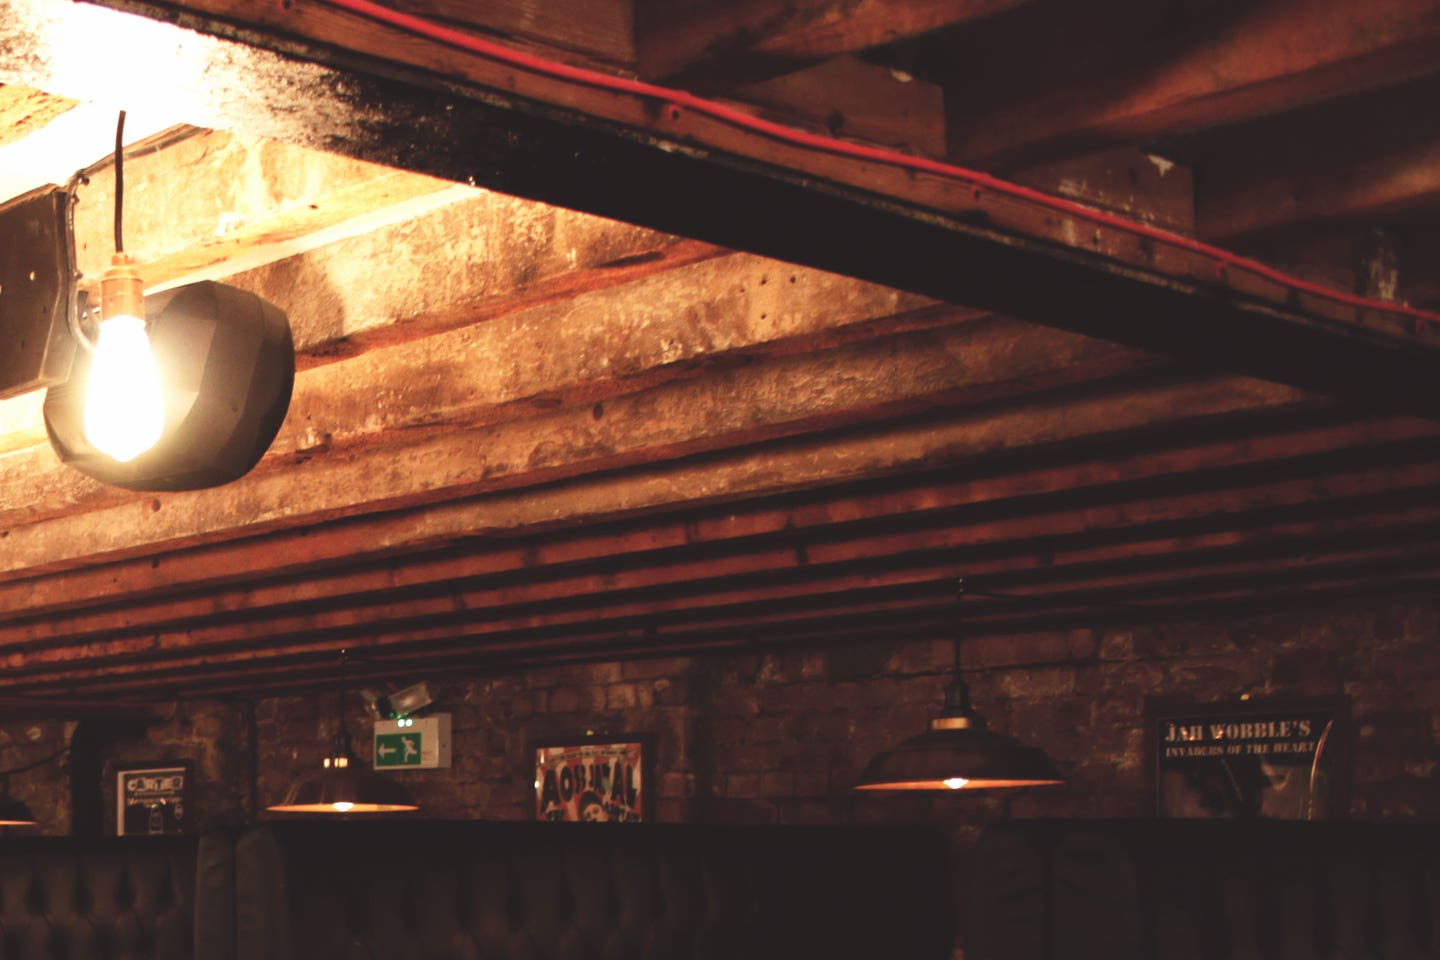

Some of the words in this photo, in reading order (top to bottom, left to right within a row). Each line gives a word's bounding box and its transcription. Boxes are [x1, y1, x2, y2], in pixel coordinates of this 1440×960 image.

[1164, 723, 1203, 742] JAH
[1210, 720, 1312, 740] WOBBLE'S
[1165, 746, 1224, 757] INVADERS
[1227, 745, 1243, 755] OF
[1246, 744, 1269, 754] THE
[1273, 742, 1315, 753] HEART
